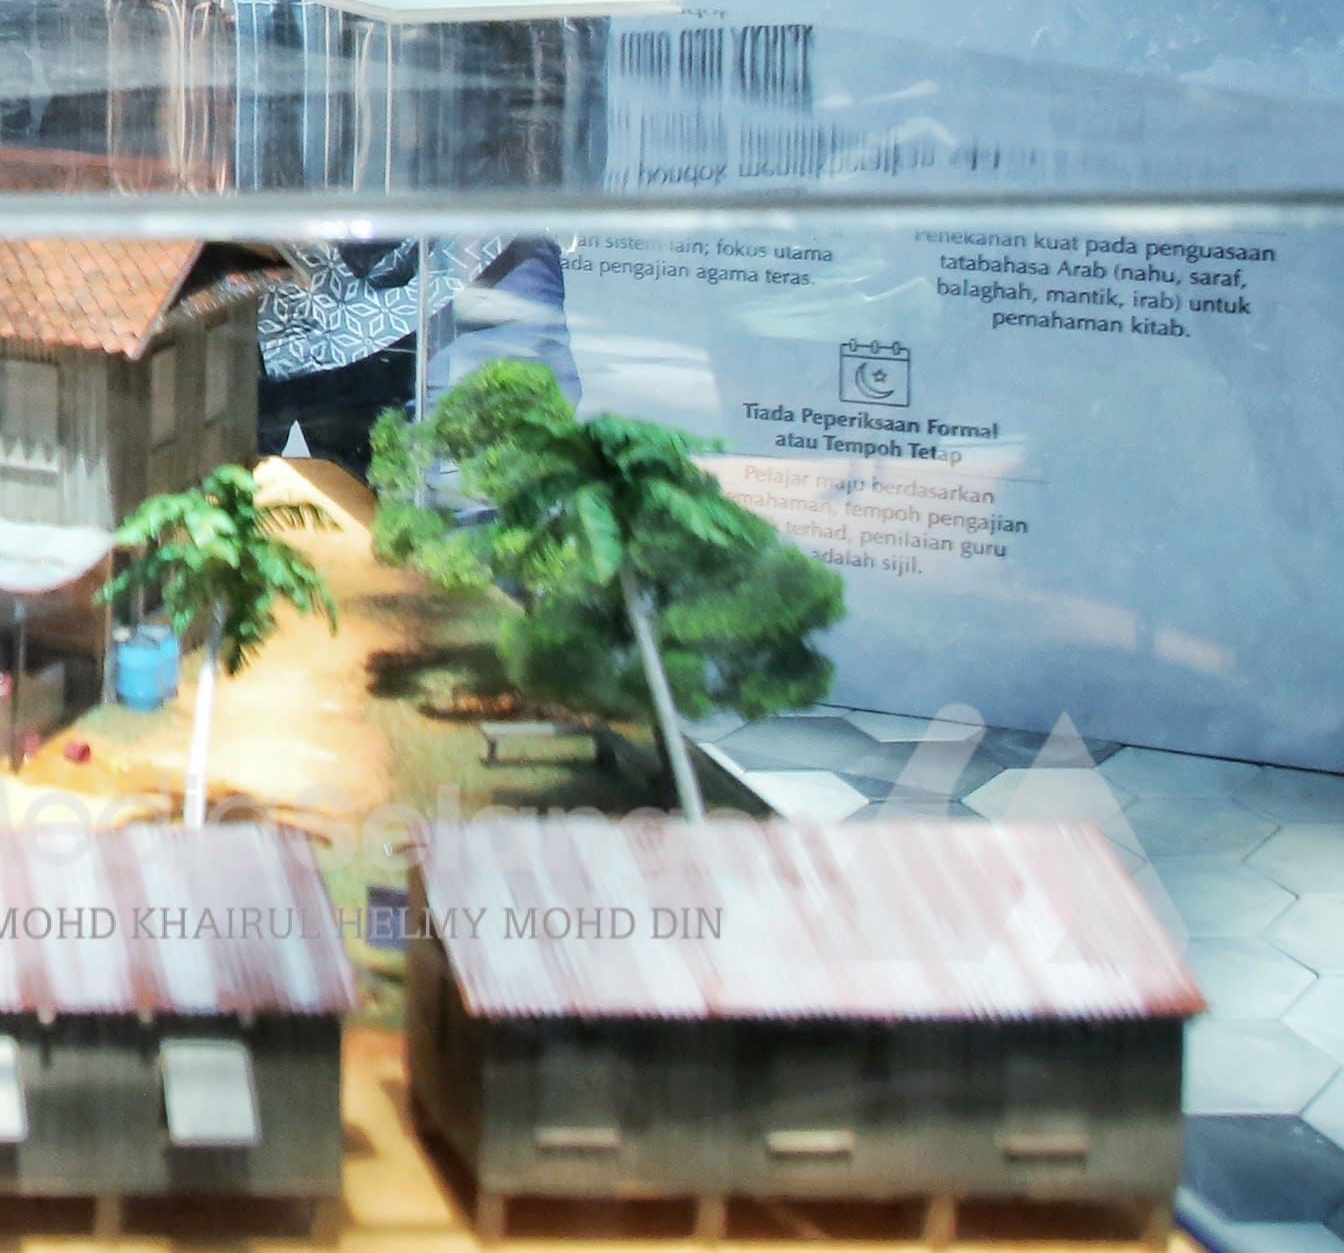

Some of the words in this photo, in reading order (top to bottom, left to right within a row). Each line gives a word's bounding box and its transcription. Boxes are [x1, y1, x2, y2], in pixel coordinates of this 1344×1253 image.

[716, 238, 767, 258] fokus
[774, 246, 832, 262] utama
[1034, 232, 1079, 252] kuat
[1085, 237, 1138, 258] pada
[1145, 241, 1277, 264] penguasaan
[599, 258, 689, 281] pengajian
[696, 266, 759, 284] agama
[940, 254, 1050, 278] tatabahasa
[1056, 260, 1106, 280] Arab
[1114, 262, 1181, 287] (nahu,
[1189, 269, 1248, 291] saraf,
[936, 277, 1038, 304] balaghah,
[1046, 286, 1124, 309] mantik,
[1133, 290, 1182, 314] irab)
[1189, 296, 1252, 315] untuk
[992, 309, 1124, 334] pemahaman
[1131, 316, 1191, 338] kitab.
[743, 402, 795, 422] Tiada
[801, 408, 921, 433] Peperiksaan
[928, 417, 999, 439] Formal
[775, 434, 818, 450] atau
[823, 435, 903, 458] Tempoh
[908, 442, 962, 467] Tetap
[744, 465, 808, 490] Pelajar
[872, 475, 995, 504] berdasarkan
[844, 502, 921, 524] tempoh
[928, 510, 1030, 535] pengajian
[860, 529, 954, 552] penilaian
[960, 541, 1008, 559] guru
[882, 556, 923, 578] sijil.
